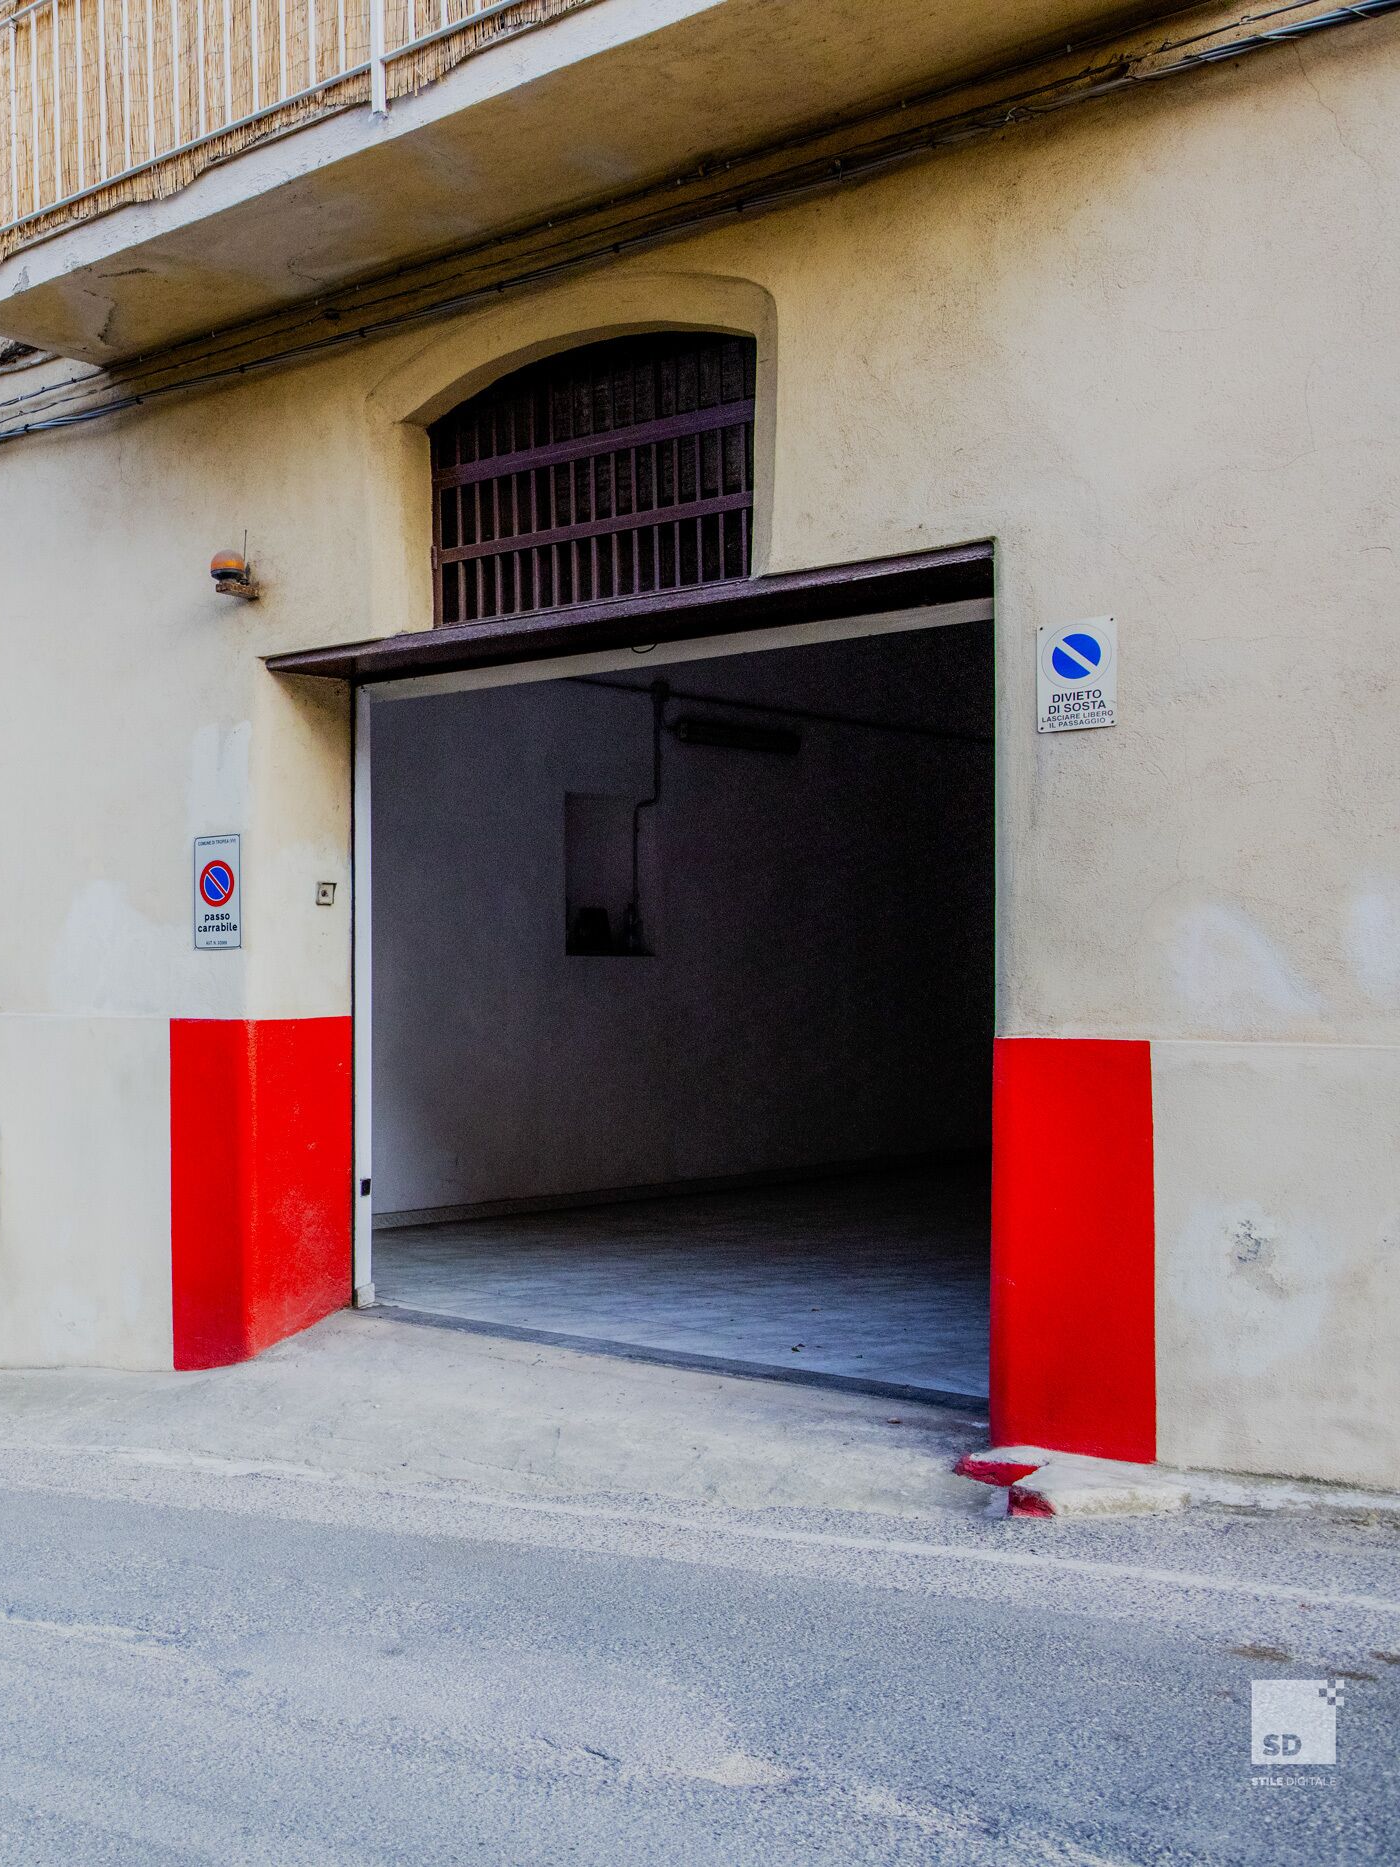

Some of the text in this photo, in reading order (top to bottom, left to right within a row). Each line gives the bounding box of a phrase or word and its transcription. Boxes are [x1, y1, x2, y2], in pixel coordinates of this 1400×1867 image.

[1052, 689, 1102, 703] DIVIETO
[1048, 700, 1107, 715] DI SOSTA
[1041, 710, 1114, 723] LASCIARE LIBERO
[1058, 718, 1106, 728] PASSAGGIO
[204, 913, 231, 923] passo
[197, 922, 238, 933] carrabile
